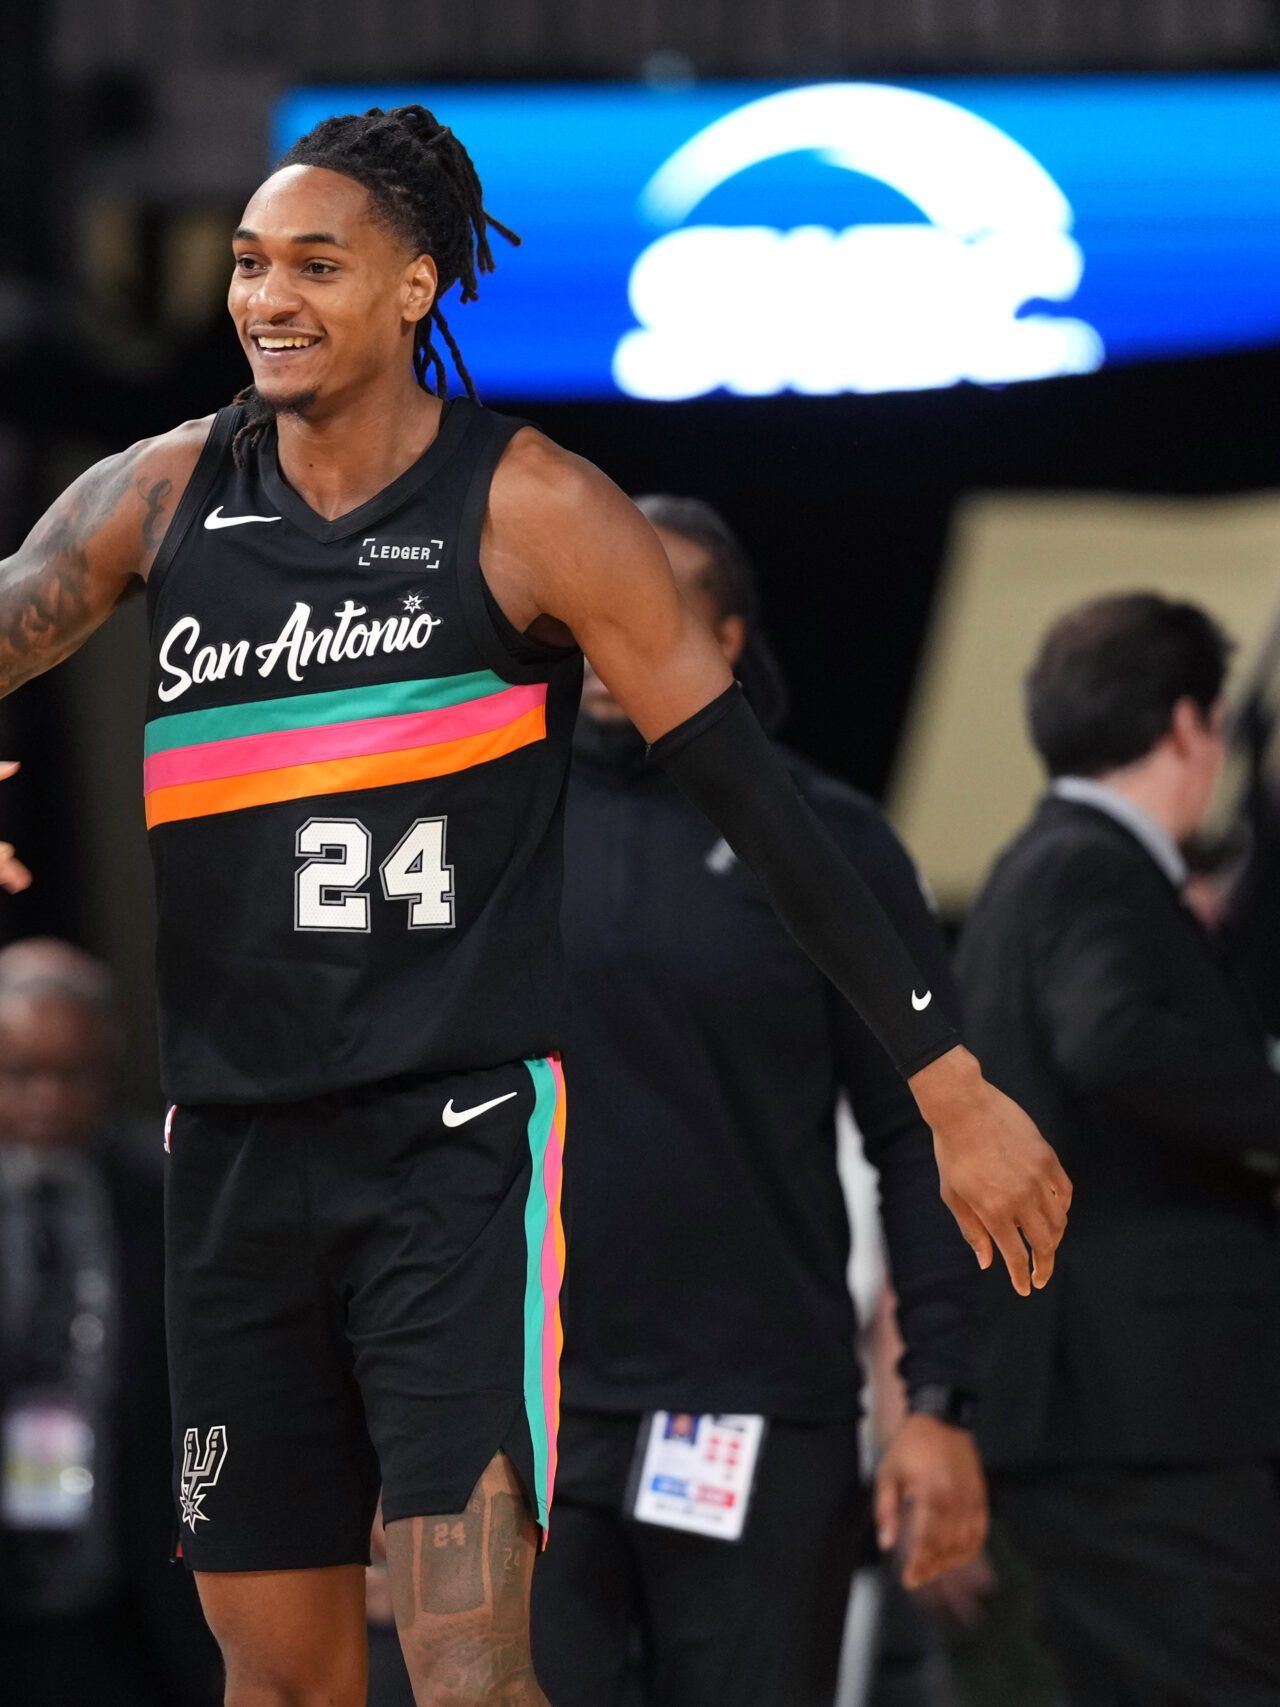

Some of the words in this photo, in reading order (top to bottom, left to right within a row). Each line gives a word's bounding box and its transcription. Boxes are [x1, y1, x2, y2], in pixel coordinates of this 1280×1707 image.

[369, 544, 432, 562] LEDGER
[157, 616, 250, 703] San
[255, 595, 442, 682] Antonio
[293, 814, 456, 933] 24
[433, 1521, 466, 1548] 24
